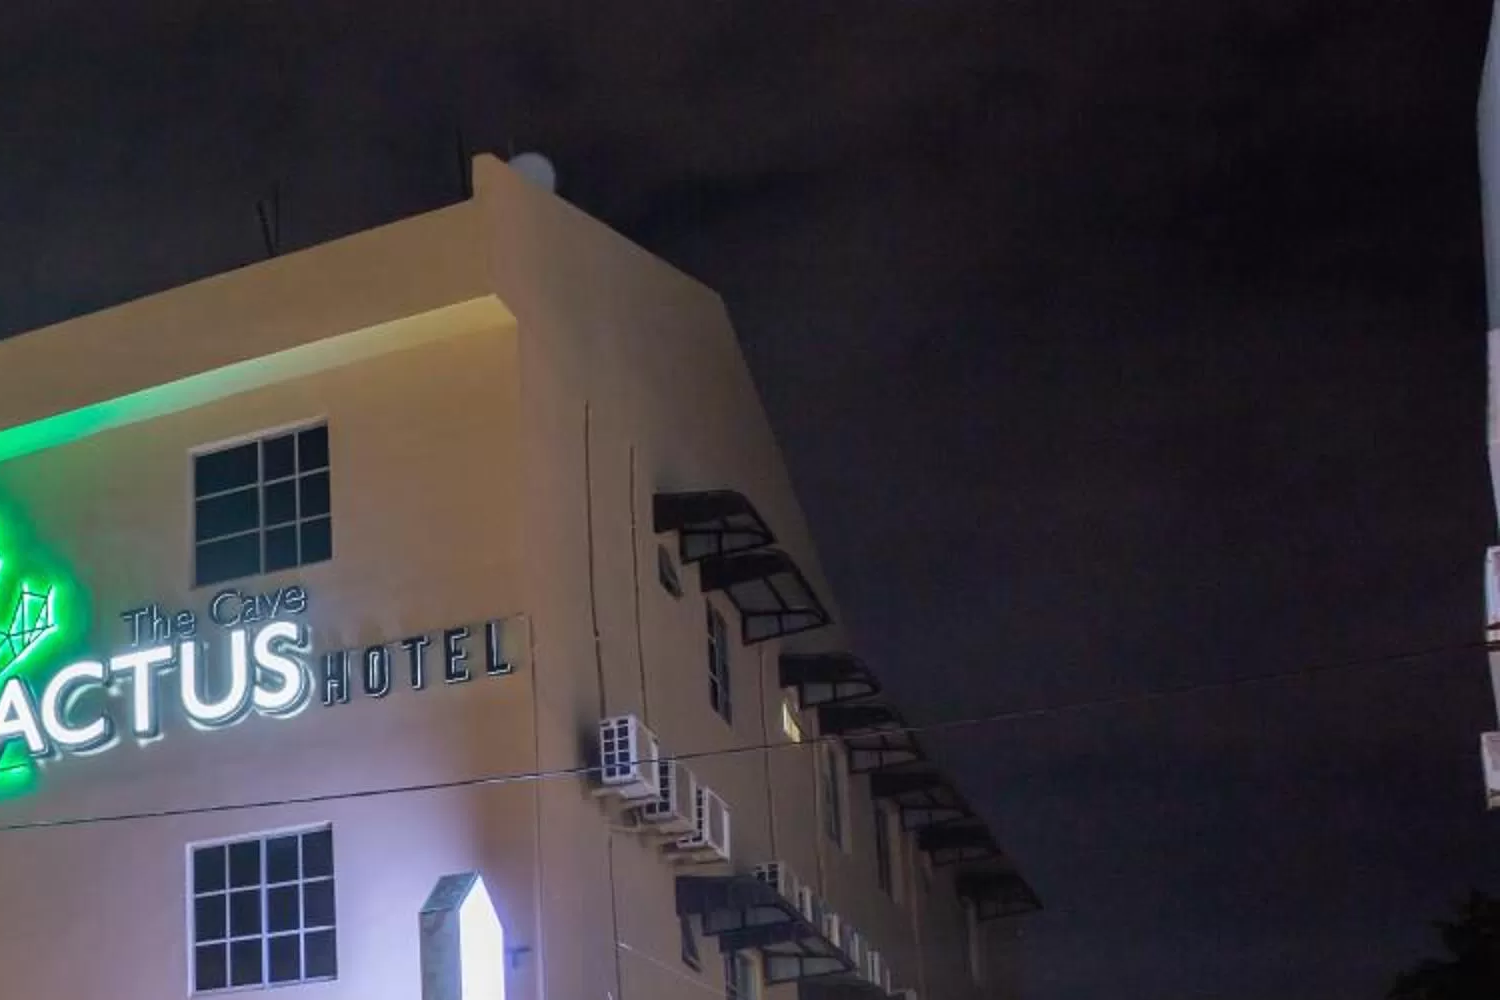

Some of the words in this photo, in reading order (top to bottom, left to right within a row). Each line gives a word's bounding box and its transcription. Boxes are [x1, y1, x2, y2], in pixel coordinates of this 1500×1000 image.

[121, 603, 197, 645] The
[209, 585, 308, 627] Cave
[321, 622, 512, 706] HOTEL
